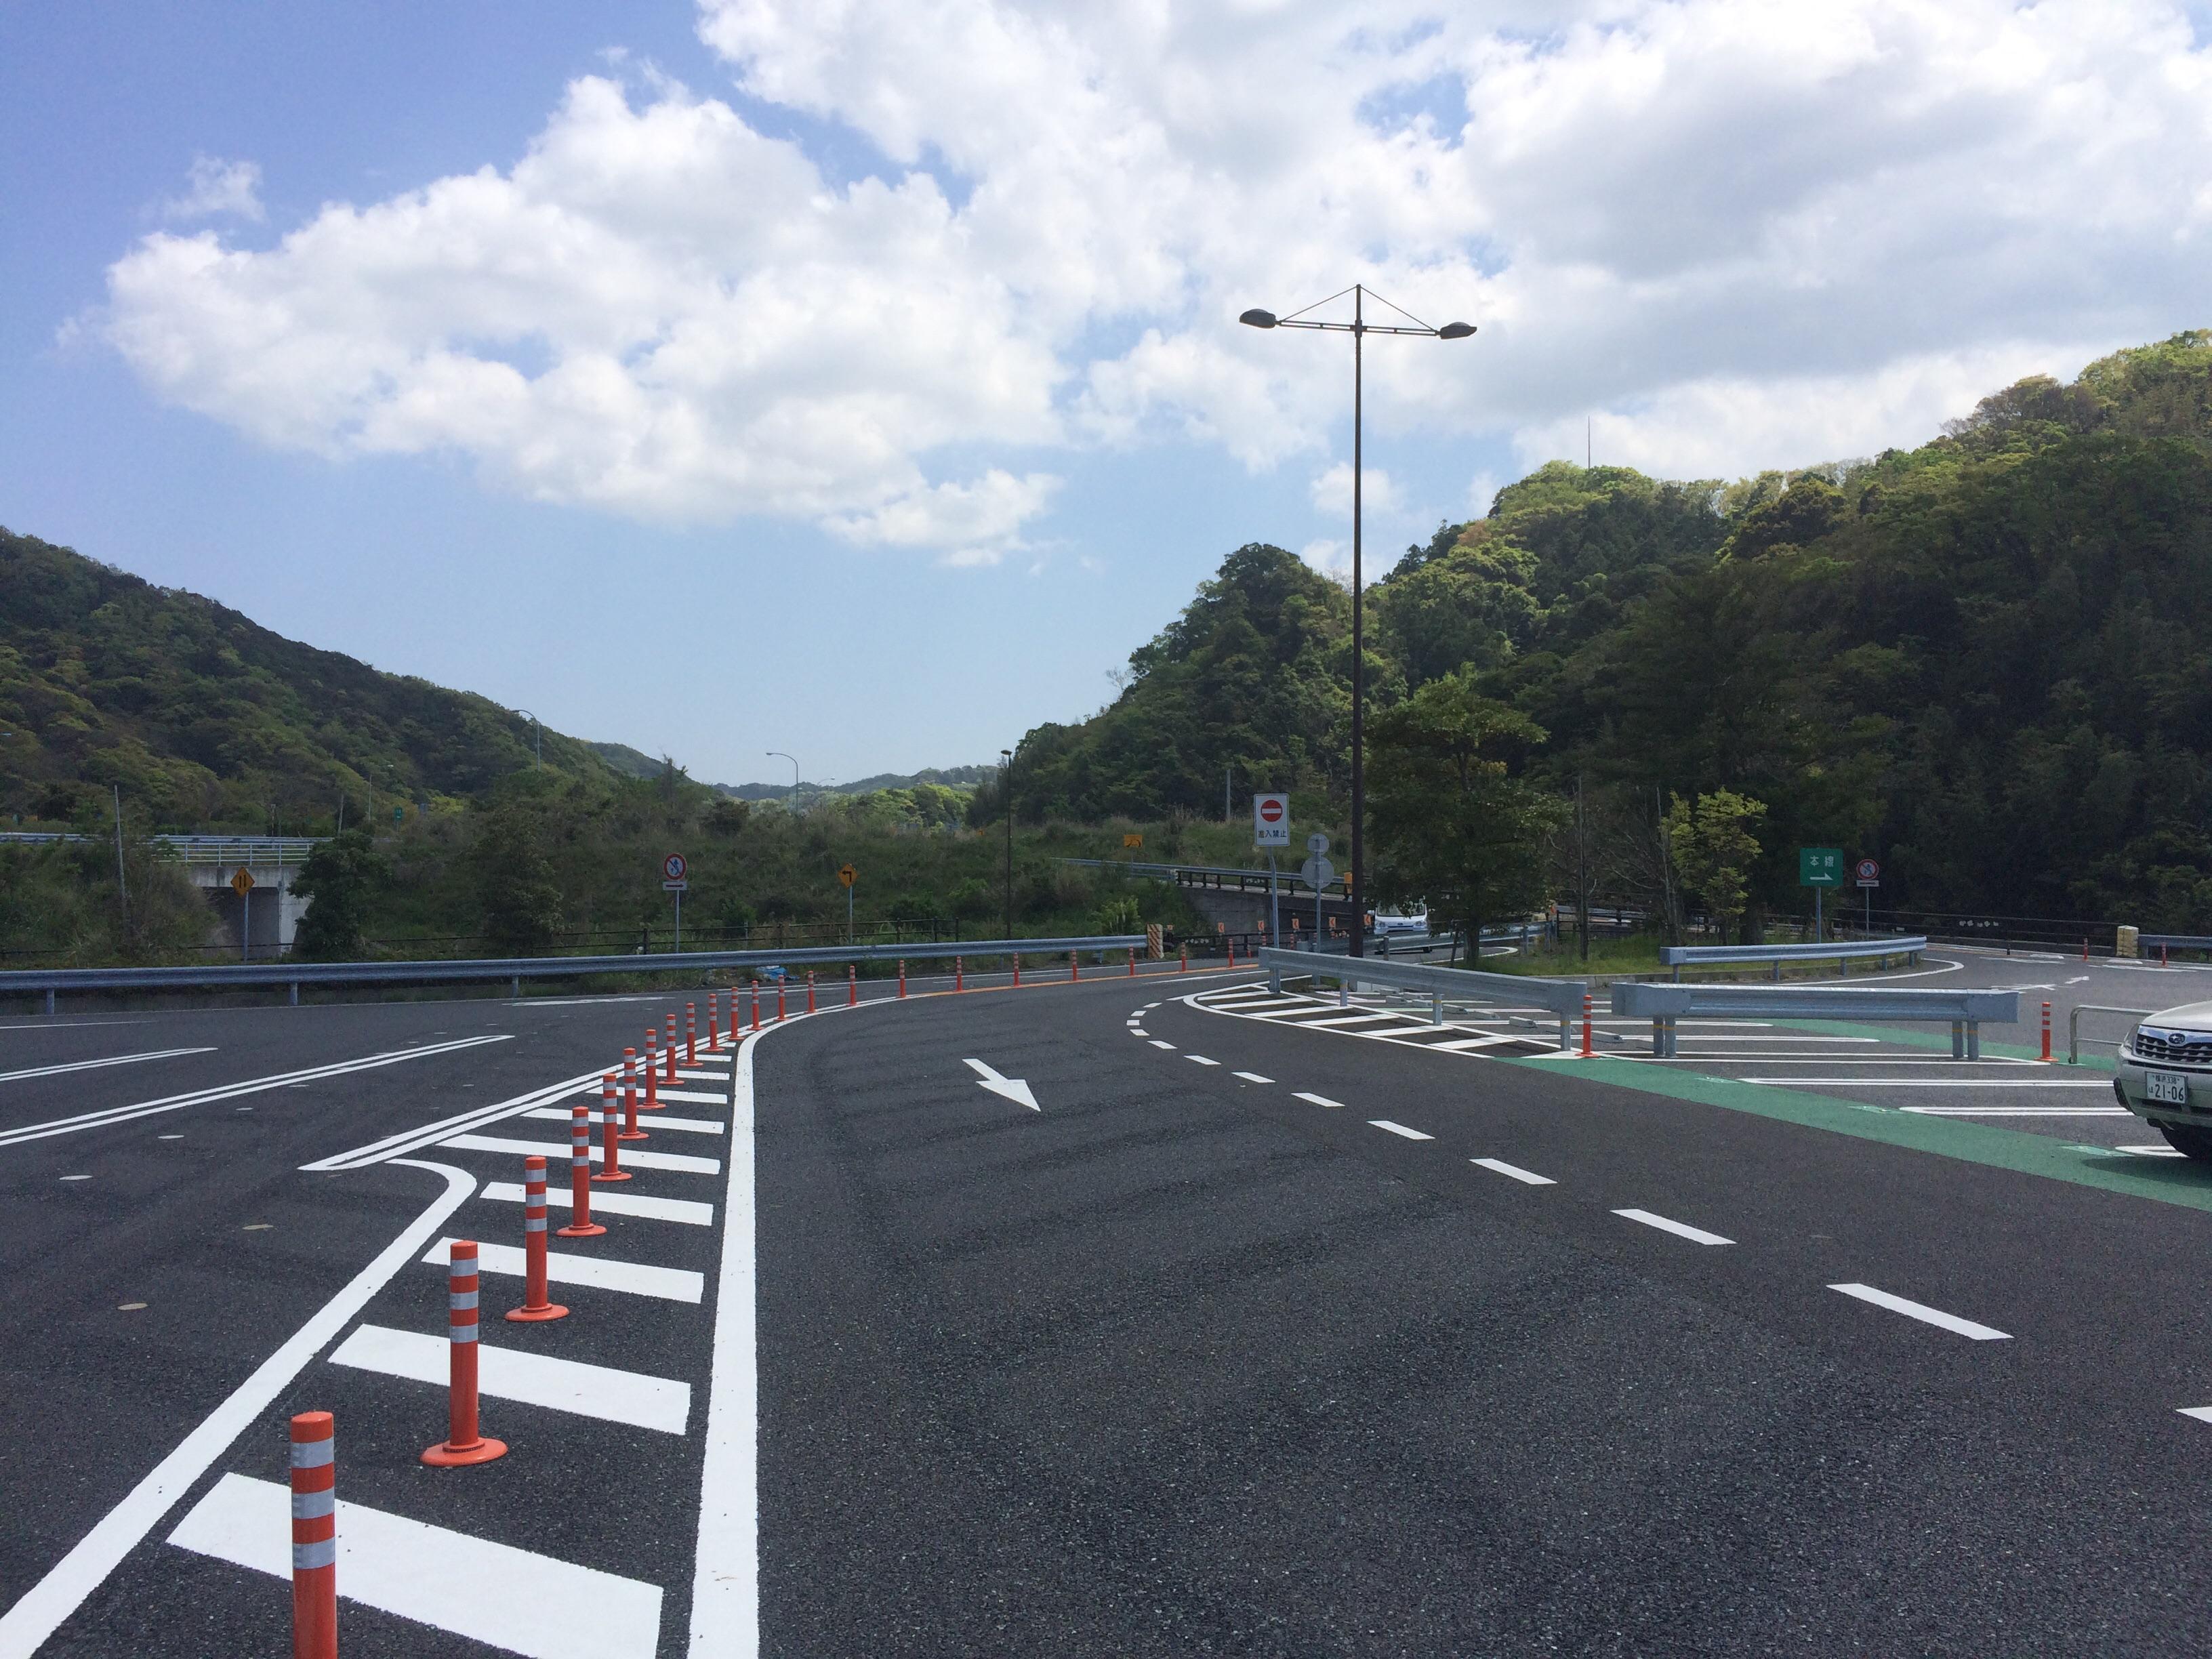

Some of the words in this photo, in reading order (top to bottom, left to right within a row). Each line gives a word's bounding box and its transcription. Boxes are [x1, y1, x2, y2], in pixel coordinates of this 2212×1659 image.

[1258, 830, 1287, 838] 進入禁止
[1809, 855, 1834, 867] 本線
[2155, 1084, 2184, 1101] 21-06
